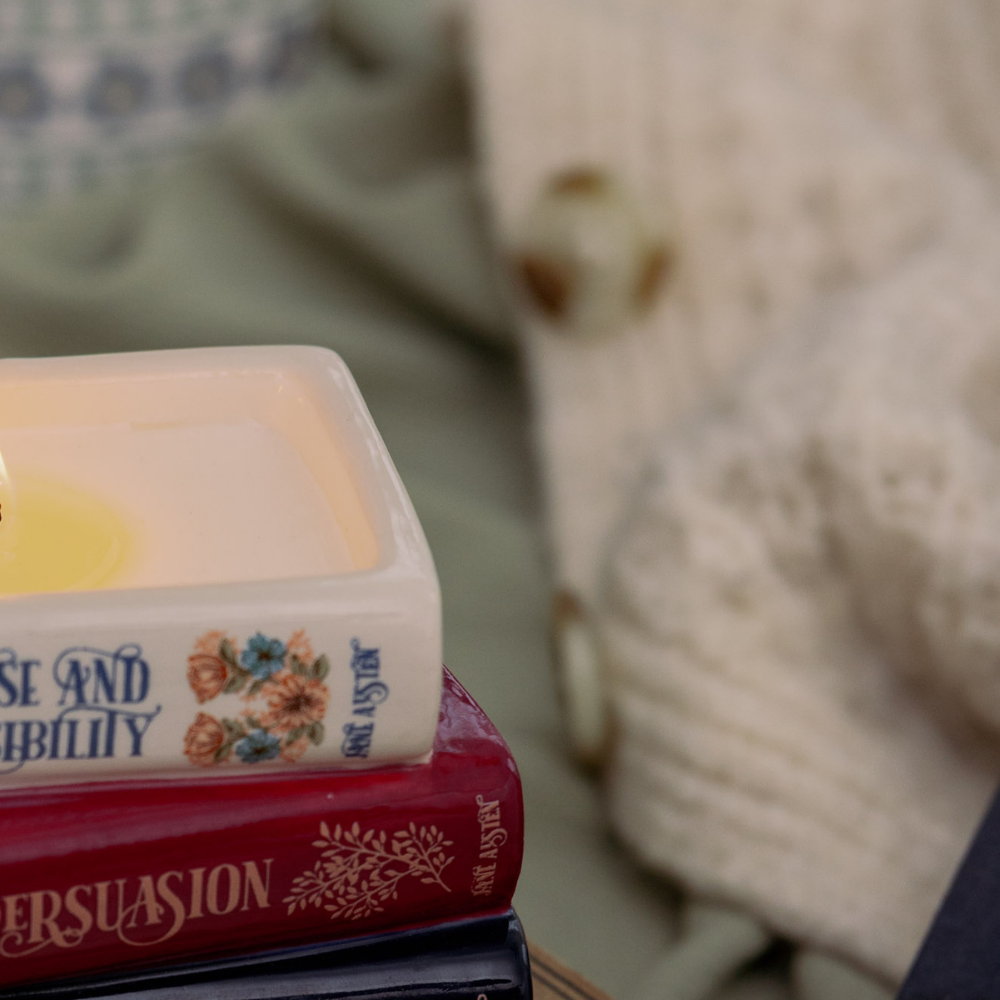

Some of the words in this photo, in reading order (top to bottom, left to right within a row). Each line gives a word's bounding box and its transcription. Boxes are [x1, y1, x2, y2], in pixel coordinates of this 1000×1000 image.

[53, 643, 151, 706] AND
[349, 636, 390, 718] AUSTEN
[475, 794, 508, 859] AUSTEN
[470, 862, 497, 896] JANE
